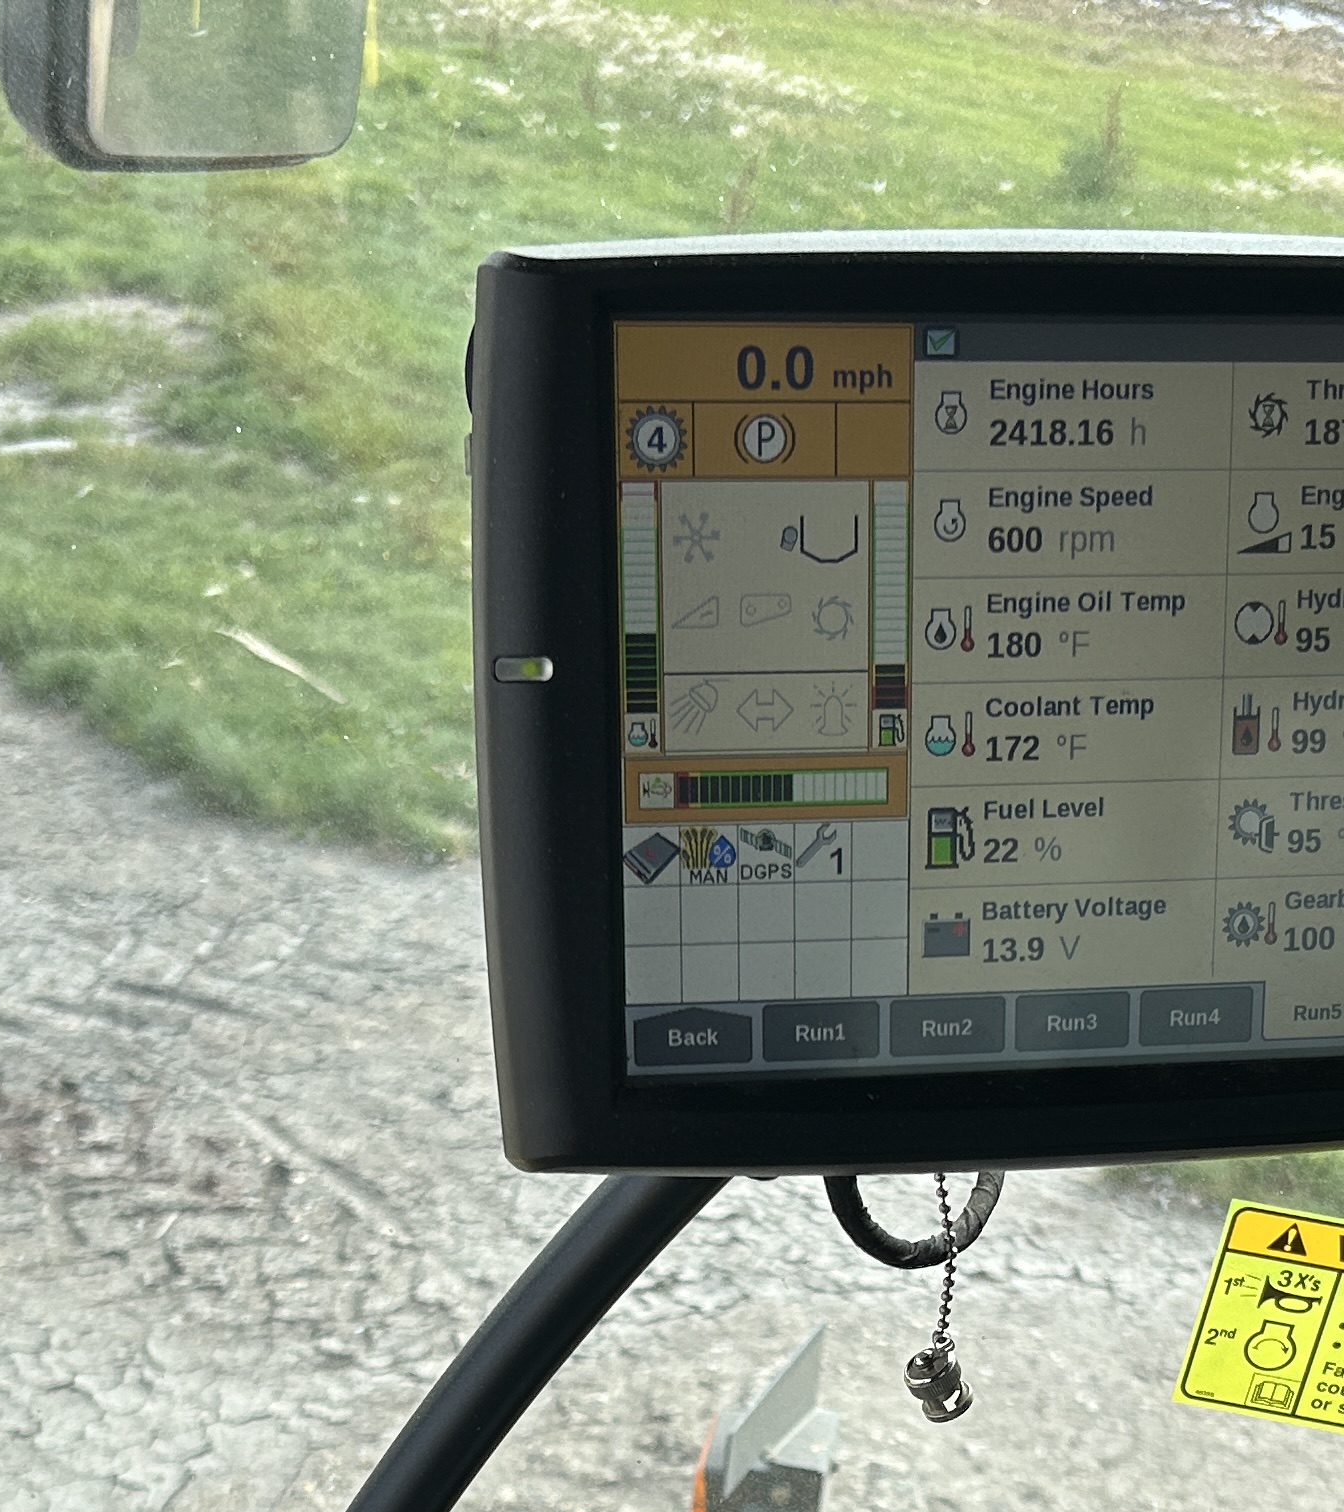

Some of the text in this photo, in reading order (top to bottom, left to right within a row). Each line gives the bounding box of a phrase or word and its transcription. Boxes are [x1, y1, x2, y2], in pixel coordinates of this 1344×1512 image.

[736, 345, 893, 394] 0.0 mph
[989, 379, 1154, 406] Engine Hours
[647, 426, 667, 453] 4
[757, 421, 775, 457] P
[989, 417, 1146, 446] 2418.16 h
[988, 485, 1153, 514] Engine Speed
[987, 526, 1115, 559] 600 rpm
[1300, 524, 1336, 550] 15
[987, 591, 1186, 619] Engine Oil Temp
[986, 631, 1042, 658] 180
[1295, 626, 1330, 652] 95
[985, 696, 1154, 720] Coolant Temp
[985, 735, 1040, 762] 172
[1291, 729, 1326, 754] 99
[983, 797, 1104, 820] Fuel Level
[983, 838, 1019, 864] 22
[1287, 829, 1321, 854] 95
[740, 864, 792, 881] DGPS
[830, 848, 843, 875] 1
[689, 870, 728, 884] MAN
[981, 897, 1166, 924] Battery Voltage
[982, 935, 1081, 963] 13.9 V
[1283, 926, 1335, 952] 100
[1047, 1013, 1097, 1032] Run3
[1169, 1009, 1221, 1028] Run4
[1293, 1003, 1342, 1022] Run5
[668, 1028, 718, 1048] Back
[795, 1023, 846, 1043] Run1
[922, 1018, 973, 1038] Run2
[1224, 1276, 1245, 1295] 1st
[1204, 1328, 1238, 1346] 2nd
[1310, 1398, 1333, 1411] or
